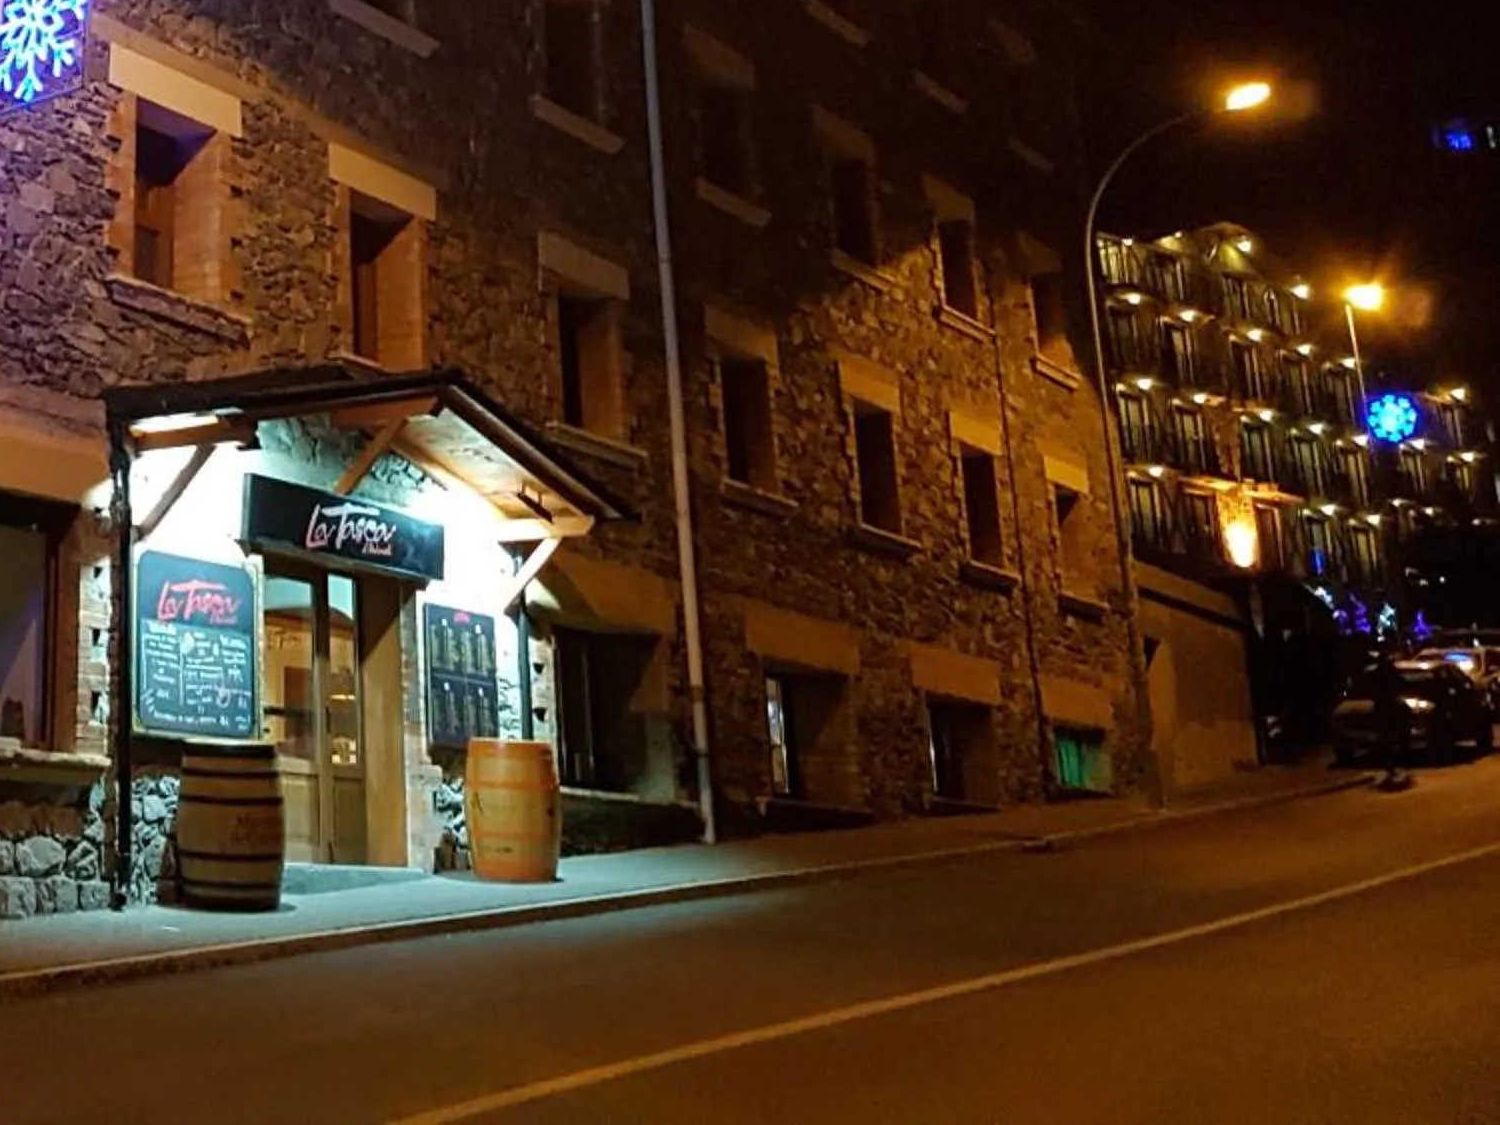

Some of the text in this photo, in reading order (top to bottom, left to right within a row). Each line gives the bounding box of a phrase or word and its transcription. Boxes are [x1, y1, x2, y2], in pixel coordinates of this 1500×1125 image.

[305, 502, 397, 550] La Tasca
[157, 579, 184, 621] La
